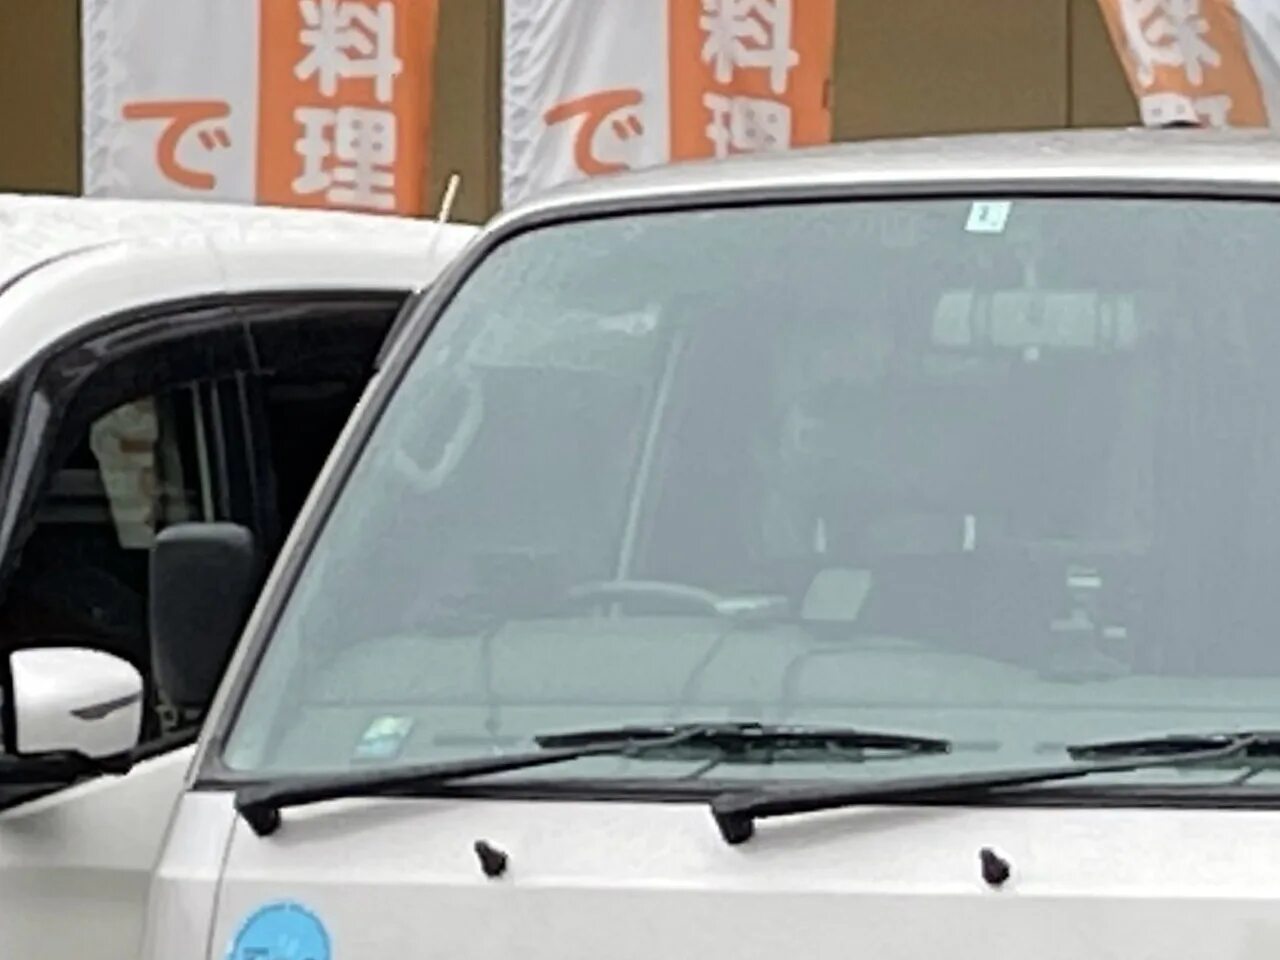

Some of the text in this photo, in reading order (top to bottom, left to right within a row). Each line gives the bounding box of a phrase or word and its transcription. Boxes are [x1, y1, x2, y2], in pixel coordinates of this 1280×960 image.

[293, 0, 403, 209] 料理
[543, 88, 643, 177] で
[699, 0, 799, 159] 料理
[122, 100, 232, 190] で
